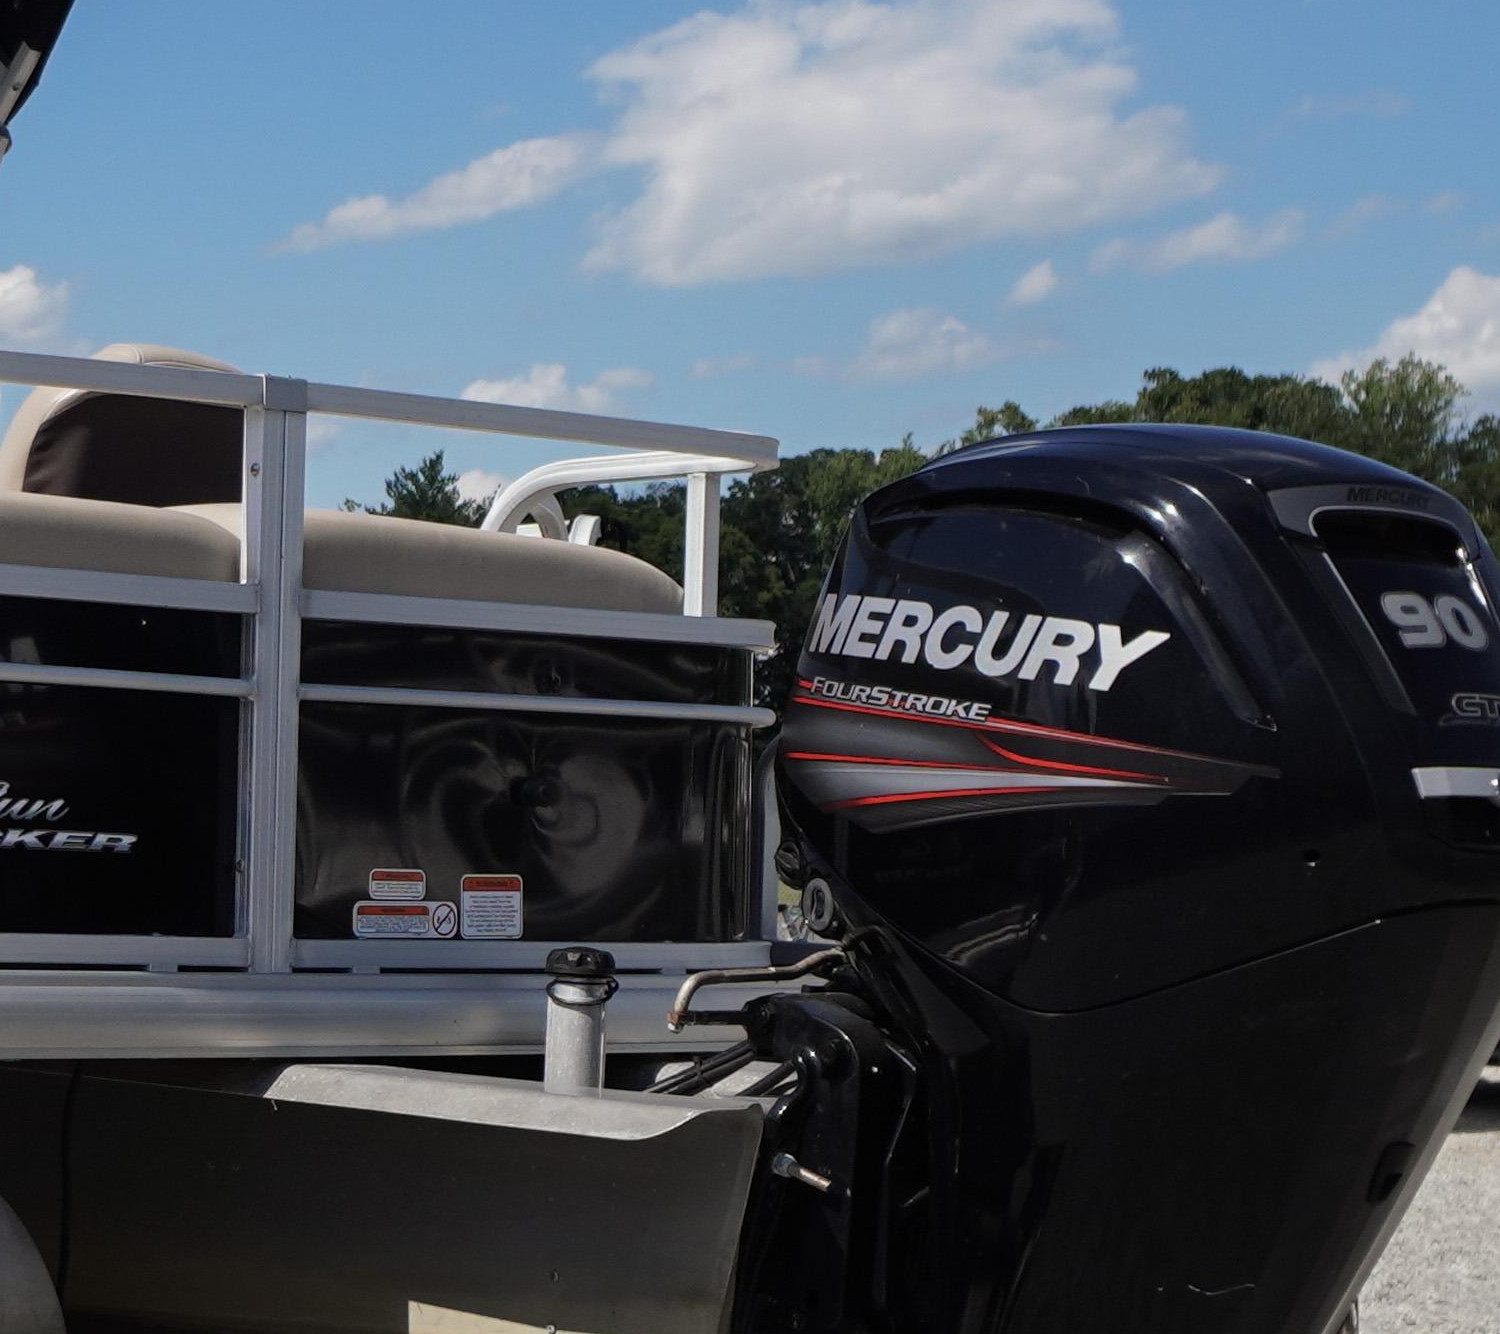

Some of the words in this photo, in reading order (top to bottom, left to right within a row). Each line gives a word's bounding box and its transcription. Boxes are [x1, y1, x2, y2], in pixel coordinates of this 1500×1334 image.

[1347, 487, 1431, 509] MERCURY
[809, 593, 1170, 692] MERCURY
[1380, 591, 1490, 652] 90
[810, 676, 992, 721] FOURSTROKE
